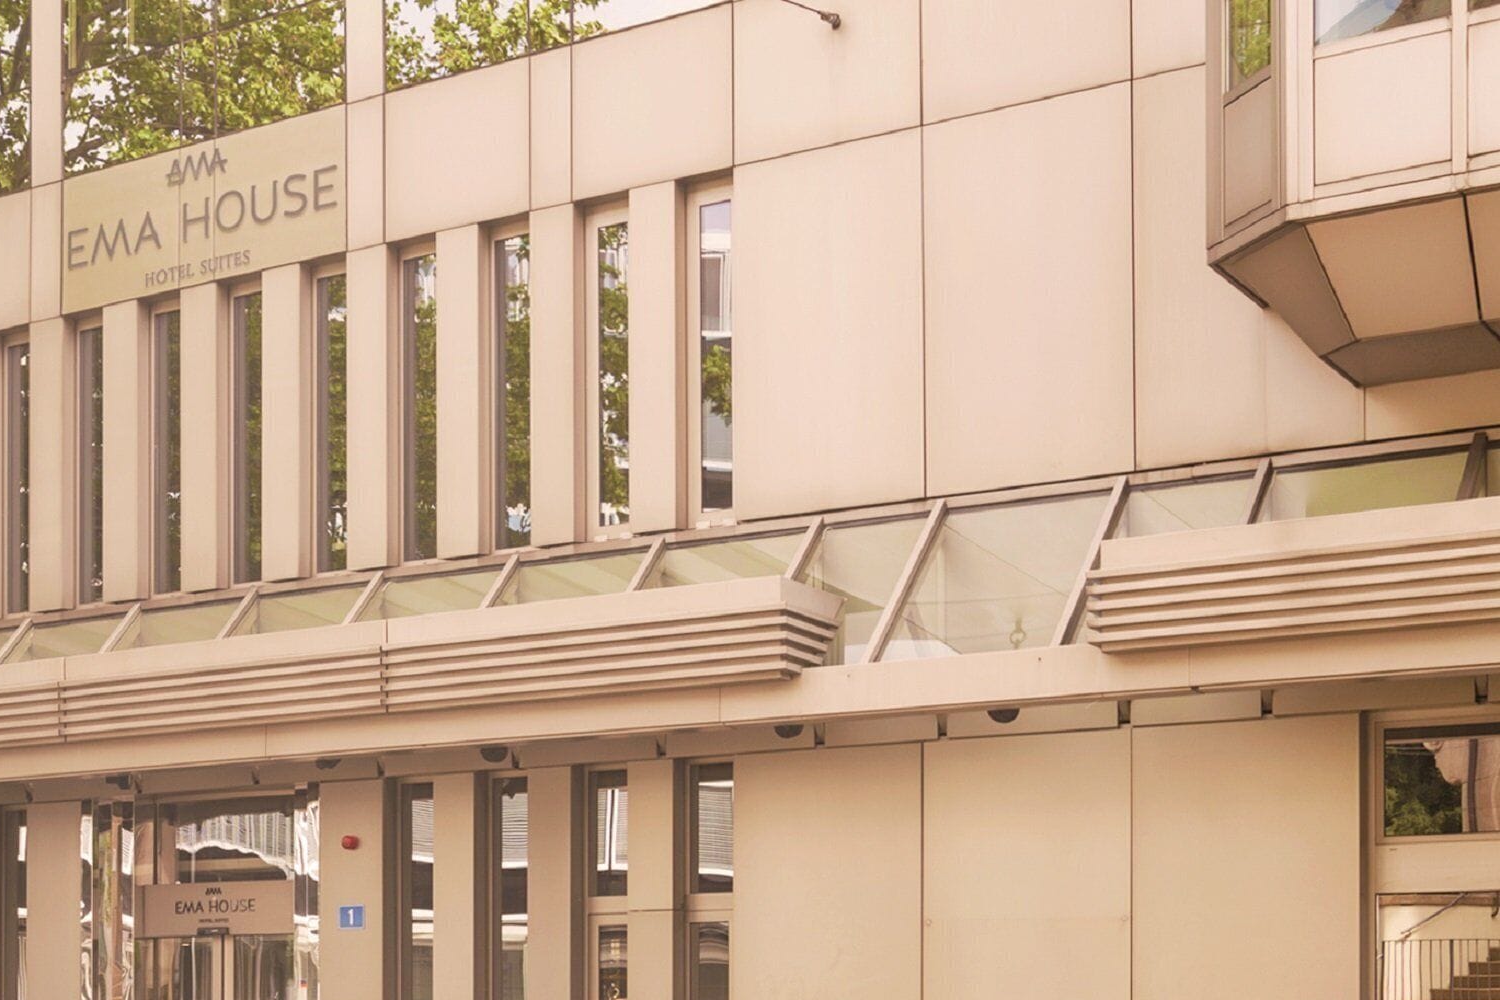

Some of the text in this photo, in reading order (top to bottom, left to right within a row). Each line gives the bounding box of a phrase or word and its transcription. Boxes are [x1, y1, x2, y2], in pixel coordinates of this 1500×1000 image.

[67, 164, 338, 270] EMA HOUSE
[145, 249, 251, 288] HOTEL SUITES
[174, 898, 256, 915] EMA HOUSE
[347, 908, 355, 926] 1
